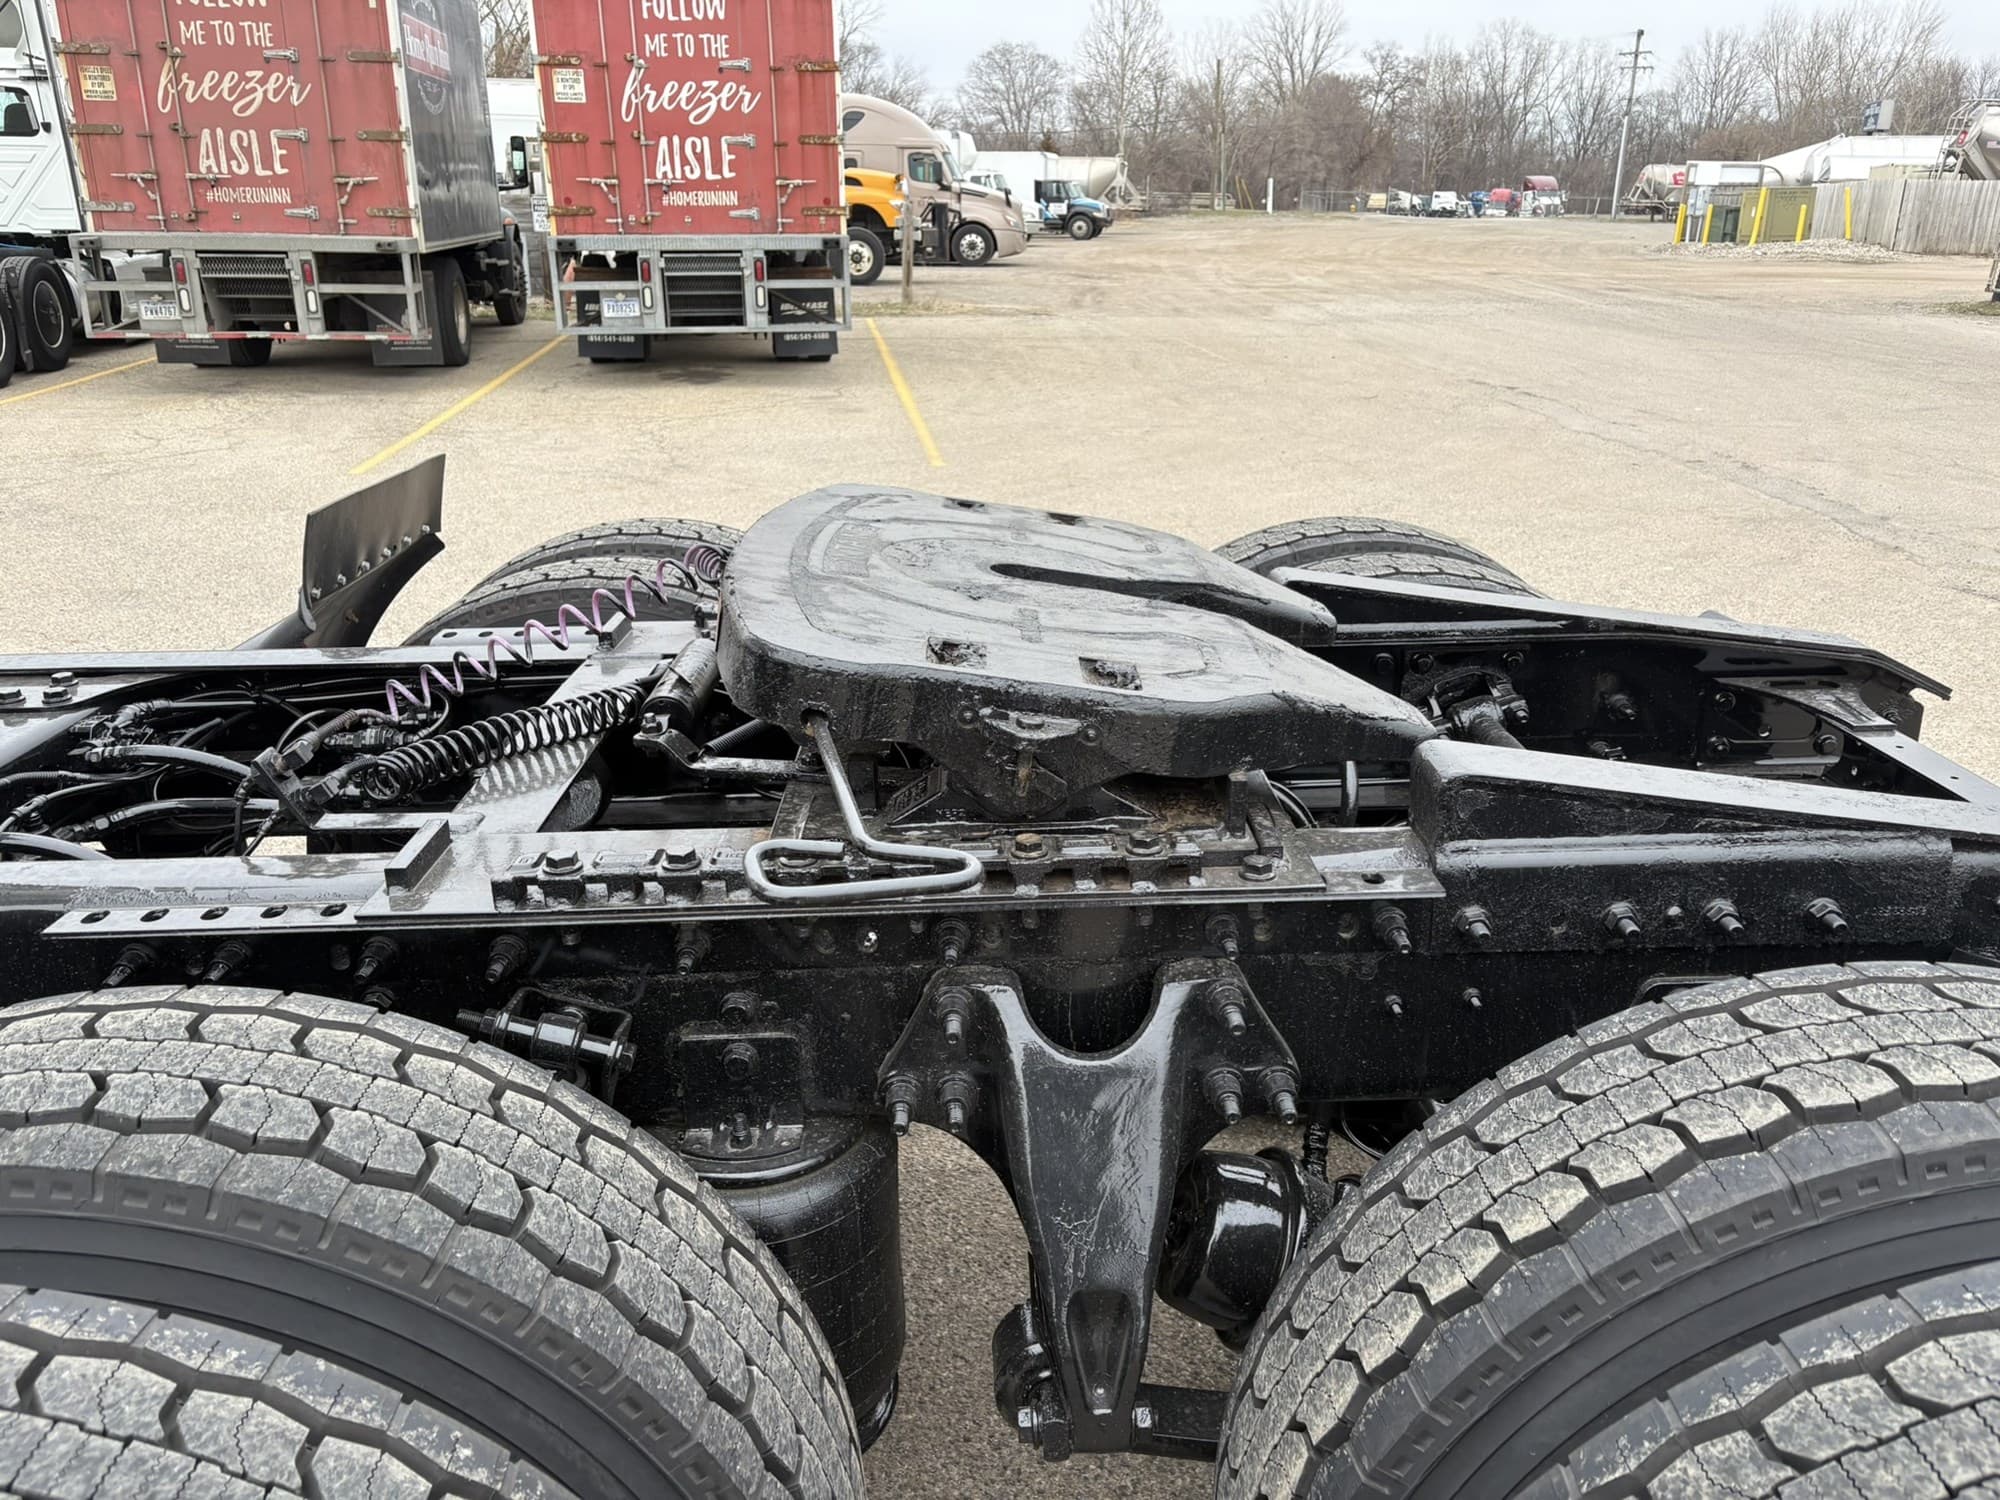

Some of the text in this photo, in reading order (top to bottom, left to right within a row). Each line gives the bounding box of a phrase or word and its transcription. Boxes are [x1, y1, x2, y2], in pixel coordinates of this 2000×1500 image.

[641, 0, 726, 21] FOLLOW
[179, 20, 274, 47] ME TO THE
[644, 33, 730, 58] ME TO THE
[157, 47, 312, 117] freezer
[621, 59, 762, 125] freezer
[200, 127, 289, 176] AISLE
[655, 134, 736, 180] AISLE
[206, 186, 292, 204] #HOMERUNINN
[662, 190, 738, 208] #HOMERUNINN
